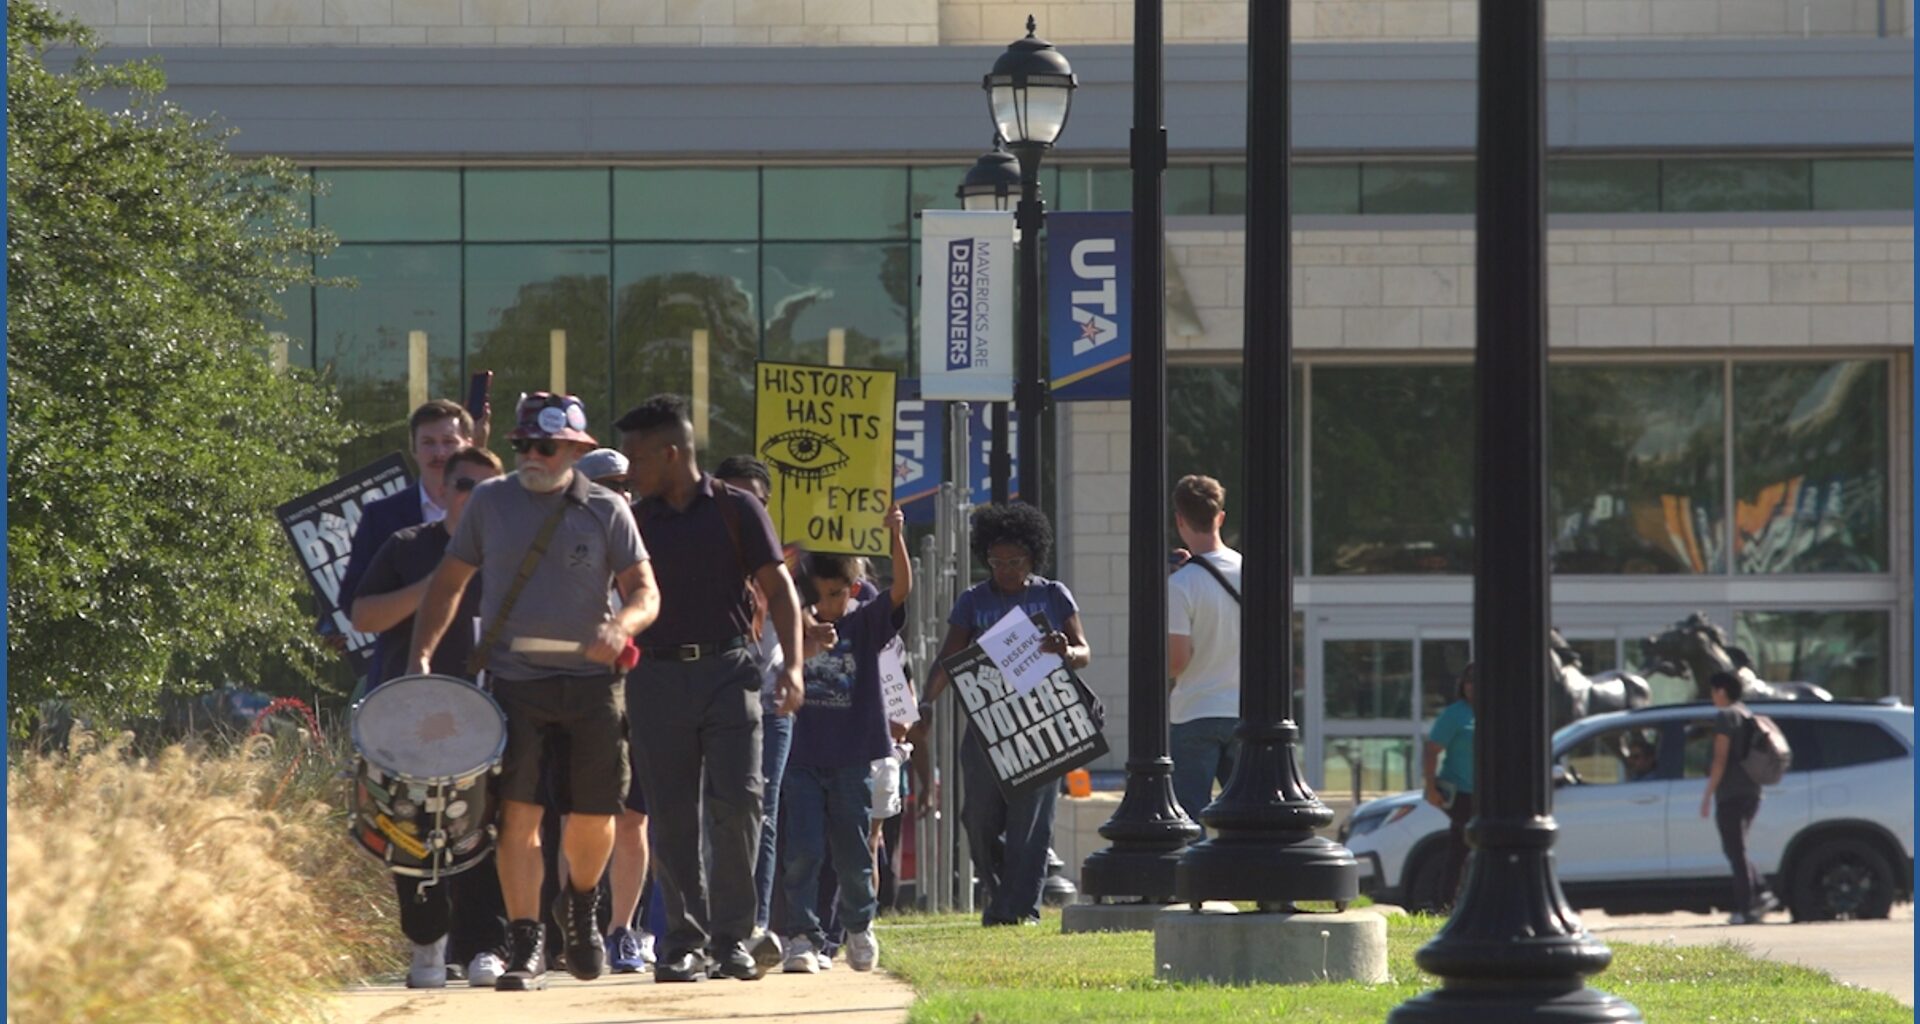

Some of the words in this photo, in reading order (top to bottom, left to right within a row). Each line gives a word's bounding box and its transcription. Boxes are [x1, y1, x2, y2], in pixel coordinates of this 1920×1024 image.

[950, 243, 970, 365] DESIGNERS
[975, 241, 990, 332] MAVERICKS
[1070, 238, 1118, 356] UTA
[975, 336, 988, 368] ARE
[764, 368, 873, 399] HISTORY
[787, 399, 834, 425] HAS
[841, 413, 880, 440] ITS
[894, 401, 925, 489] UTA
[829, 486, 888, 513] EYES
[808, 516, 844, 541] ON
[850, 528, 884, 552] US
[1001, 633, 1038, 668] DESERVE
[1003, 631, 1019, 646] WE
[972, 668, 1080, 744] VOTERS
[988, 702, 1096, 781] MATTER
